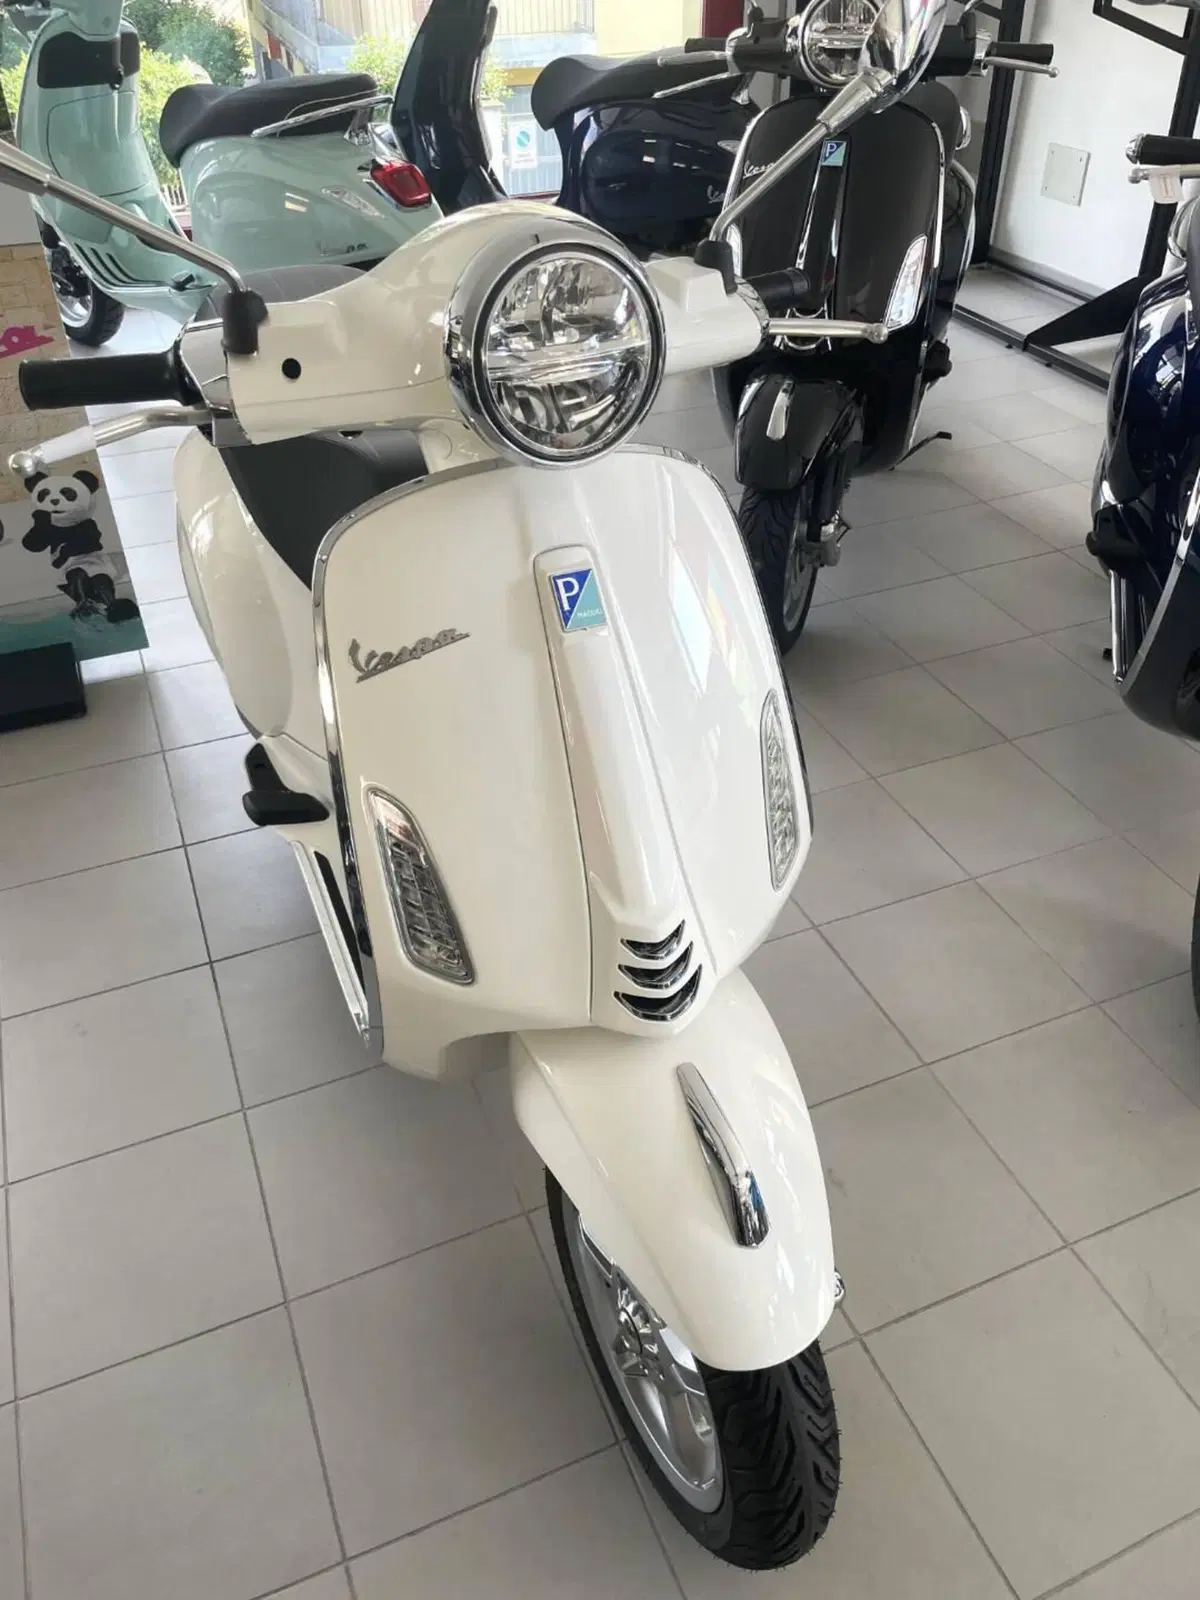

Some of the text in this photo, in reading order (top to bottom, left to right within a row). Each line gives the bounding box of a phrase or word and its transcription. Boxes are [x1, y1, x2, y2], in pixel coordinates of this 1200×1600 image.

[826, 143, 837, 157] P
[555, 577, 579, 610] P
[348, 628, 471, 684] Vespa
